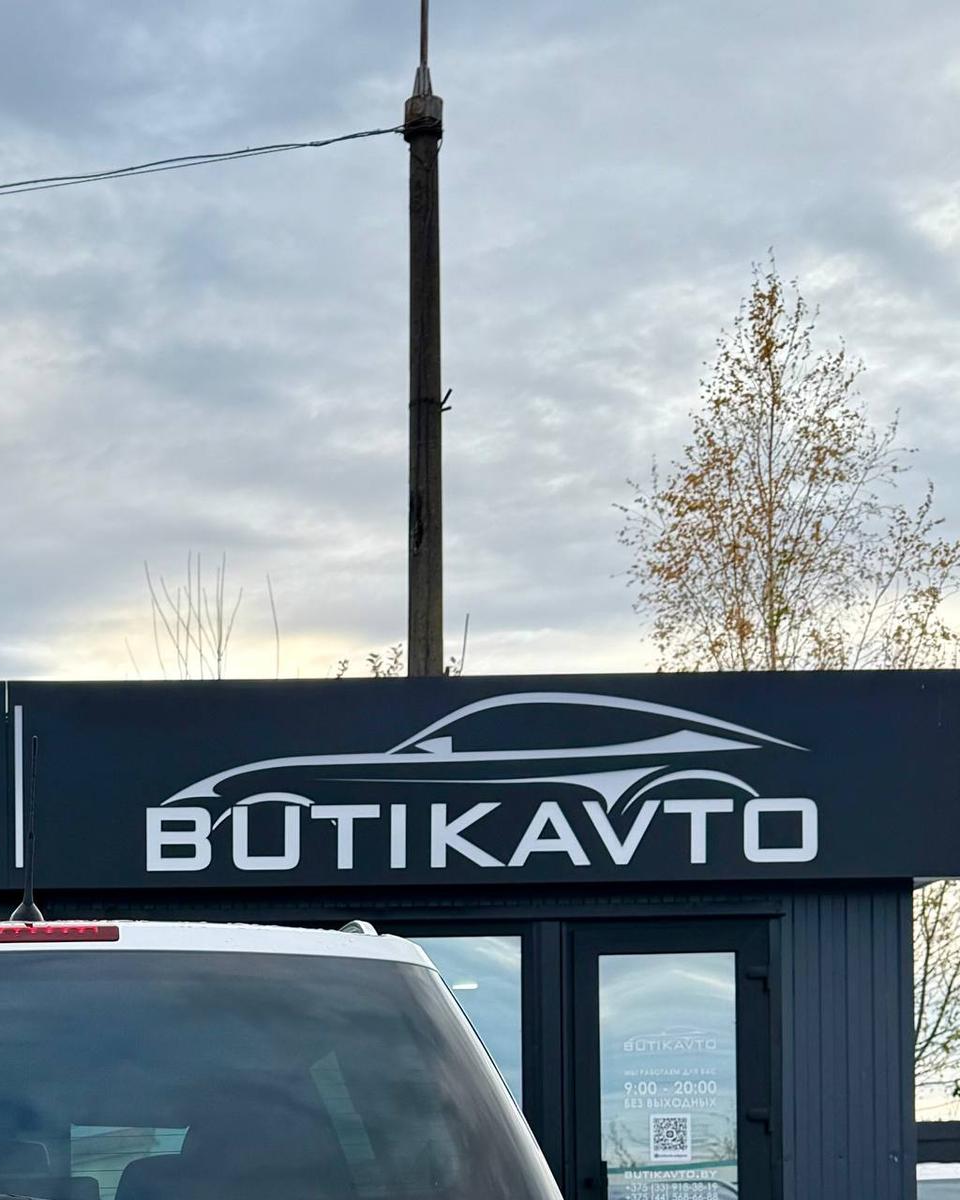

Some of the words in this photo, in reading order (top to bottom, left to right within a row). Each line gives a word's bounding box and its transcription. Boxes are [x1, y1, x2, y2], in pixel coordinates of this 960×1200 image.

[145, 796, 819, 872] BUTIKAVTO
[623, 1039, 717, 1052] BUTIKAVTO
[623, 1081, 657, 1095] 9:00
[673, 1080, 717, 1094] 20:00
[624, 1098, 643, 1109] БЕЗ
[646, 1097, 717, 1109] ВЫХОДНЫХ
[624, 1170, 718, 1180] BUTIKAVTO.BY
